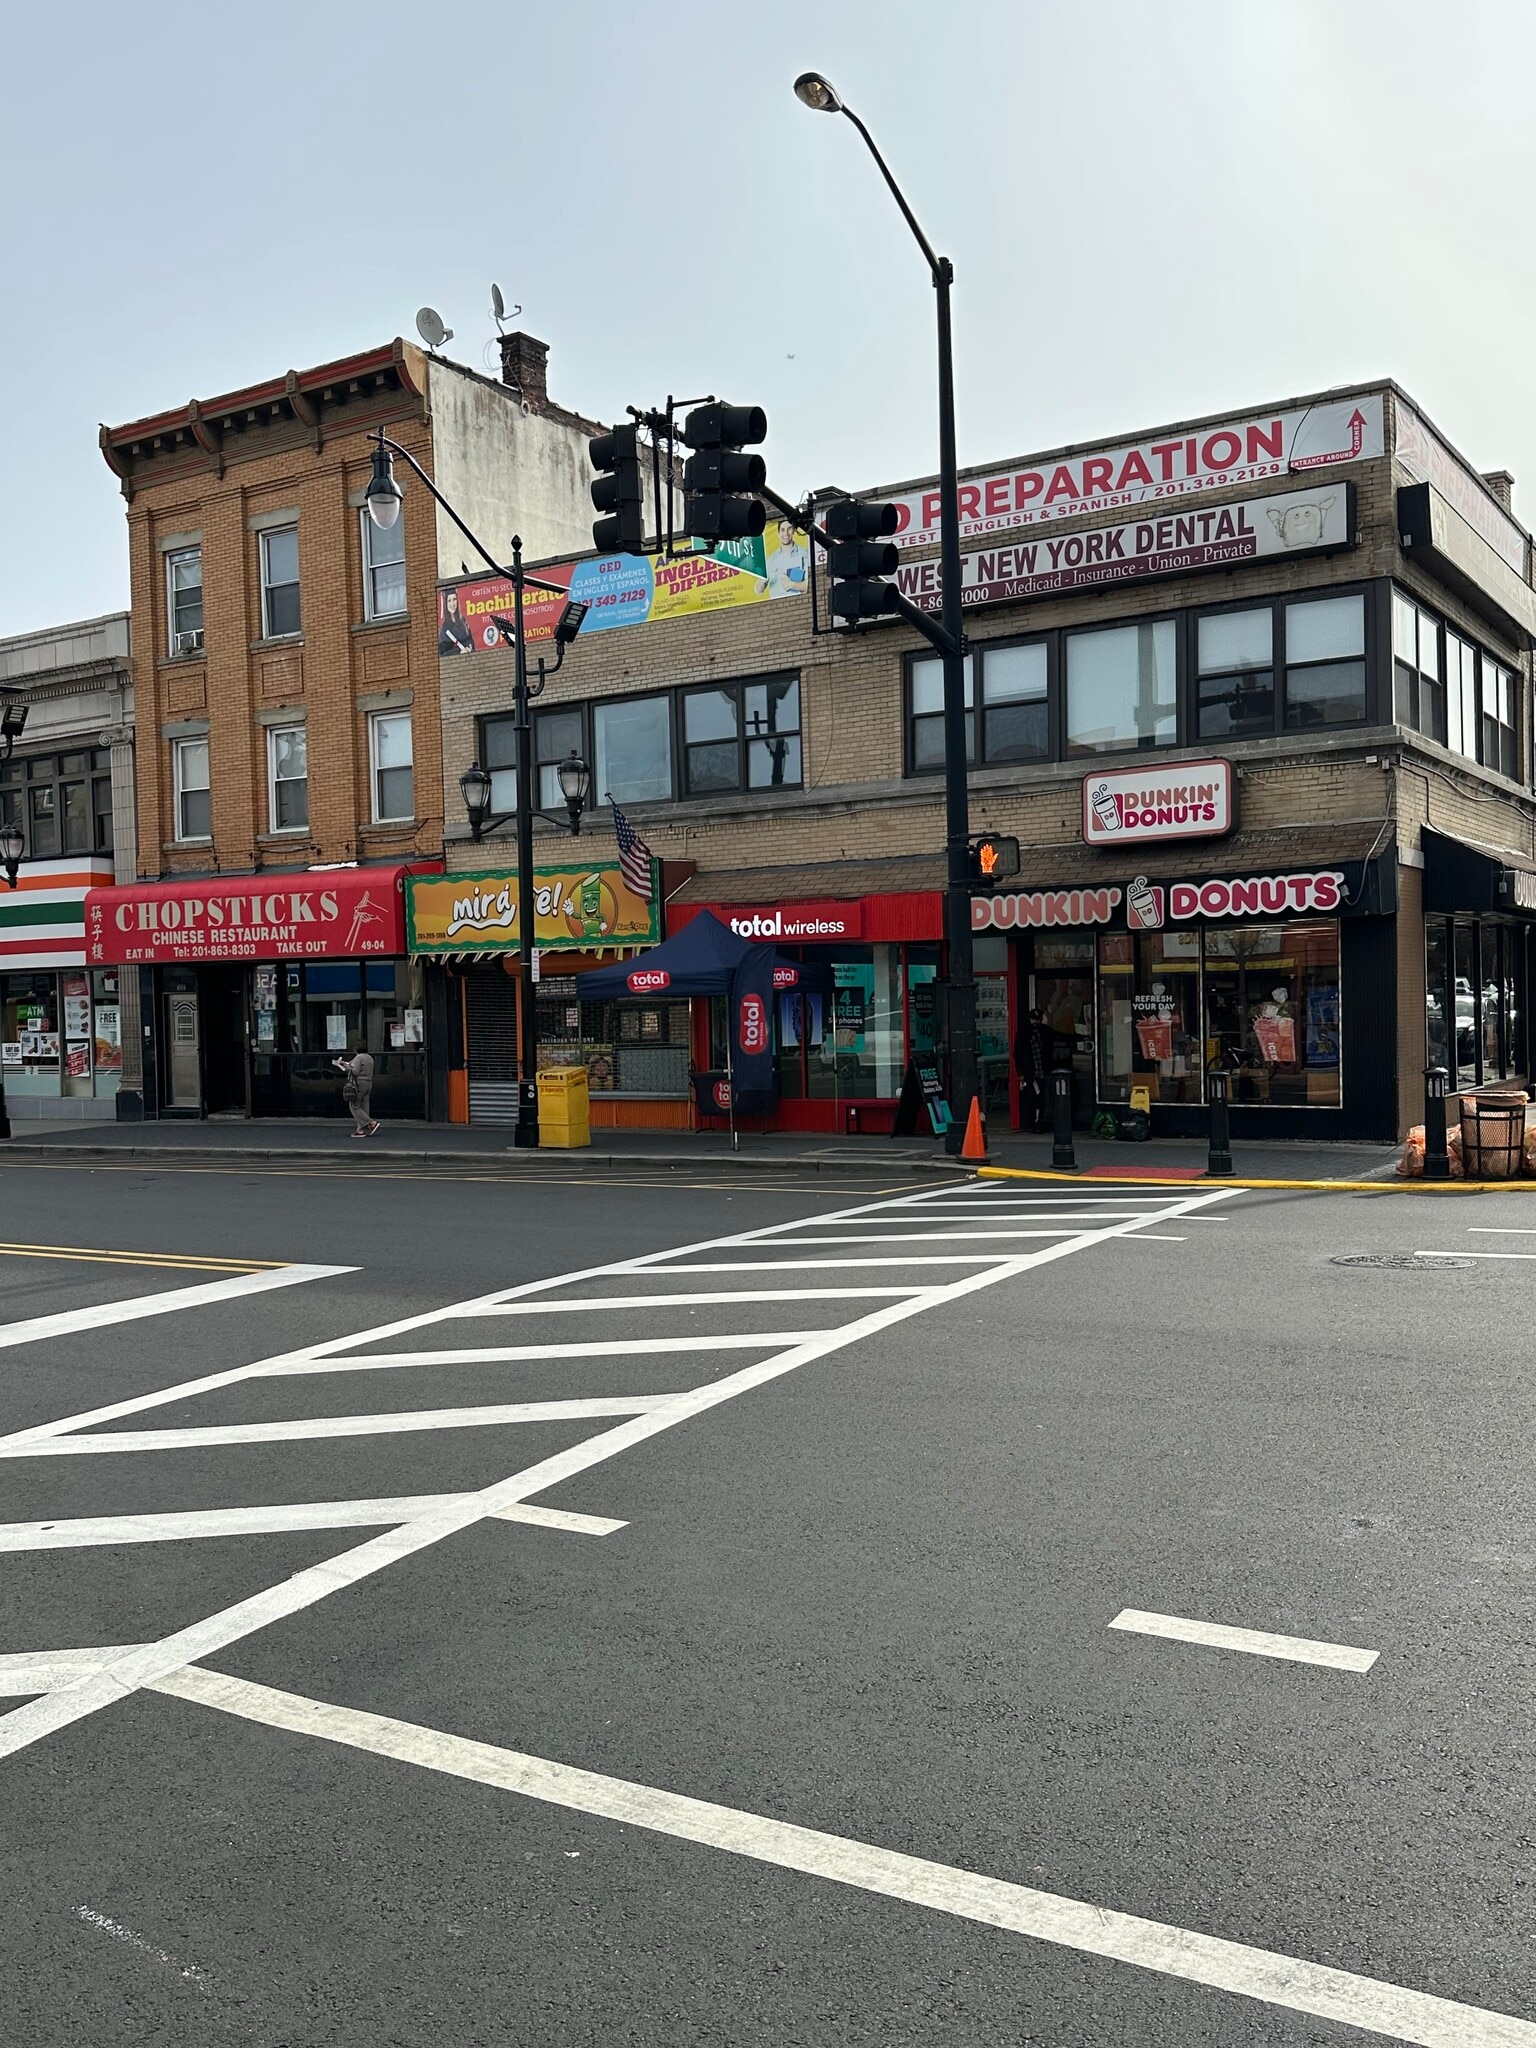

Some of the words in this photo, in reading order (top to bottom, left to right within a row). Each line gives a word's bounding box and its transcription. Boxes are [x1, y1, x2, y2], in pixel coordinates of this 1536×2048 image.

[1353, 420, 1361, 452] CORNER
[1290, 456, 1326, 468] ENTRANCE
[1326, 451, 1354, 462] AROUND
[922, 420, 1282, 529] PREPARATION
[900, 532, 936, 547] TEST
[964, 512, 1033, 534] ENGLISH
[1039, 510, 1051, 520] &
[1057, 493, 1133, 516] SPANISH
[1154, 463, 1281, 497] 201.349.2129
[743, 540, 755, 558] St
[897, 556, 969, 595] WET
[977, 544, 1038, 583] NEW
[1046, 529, 1126, 570] YORK
[1135, 506, 1255, 554] DENTAL
[599, 560, 621, 574] GED
[655, 557, 724, 587] INGLE
[1004, 573, 1062, 597] Medicaid
[1072, 563, 1136, 585] Insurance
[1148, 553, 1191, 573] Union
[1203, 542, 1252, 562] Private
[572, 589, 582, 597] EN
[584, 586, 608, 596] INGLÉS
[617, 576, 650, 589] ESPAÑOL
[575, 576, 601, 588] CLASES
[609, 568, 647, 582] EXÁMENES
[472, 586, 491, 597] OBTÉN
[491, 585, 499, 593] TU
[595, 594, 617, 608] 349
[619, 588, 646, 604] 2129
[1123, 782, 1221, 810] DUNKIN'
[1123, 804, 1216, 829] DONUTS
[1172, 876, 1338, 916] DONUTS
[115, 890, 339, 932] CHOPSTICKS
[971, 889, 1121, 928] DUNKIN'
[730, 912, 782, 938] total
[783, 918, 845, 935] wireless
[152, 929, 205, 945] CHINESE
[210, 926, 297, 943] RESTAURANT
[125, 948, 145, 959] EAT
[145, 948, 155, 958] IN
[173, 945, 190, 957] Tel:
[276, 942, 303, 954] TAKE
[305, 941, 328, 952] OUT
[632, 972, 665, 986] total
[839, 989, 852, 1005] 4
[1132, 1003, 1156, 1011] YOUR
[1157, 1002, 1176, 1011] DAY
[1134, 994, 1174, 1003] REFRESH
[26, 1006, 45, 1017] ATM
[99, 1012, 117, 1023] FREE
[838, 1017, 863, 1025] phones
[743, 1001, 760, 1047] total
[1147, 1039, 1156, 1058] ICED
[1267, 1041, 1278, 1061] ICED
[920, 1067, 939, 1080] FREE
